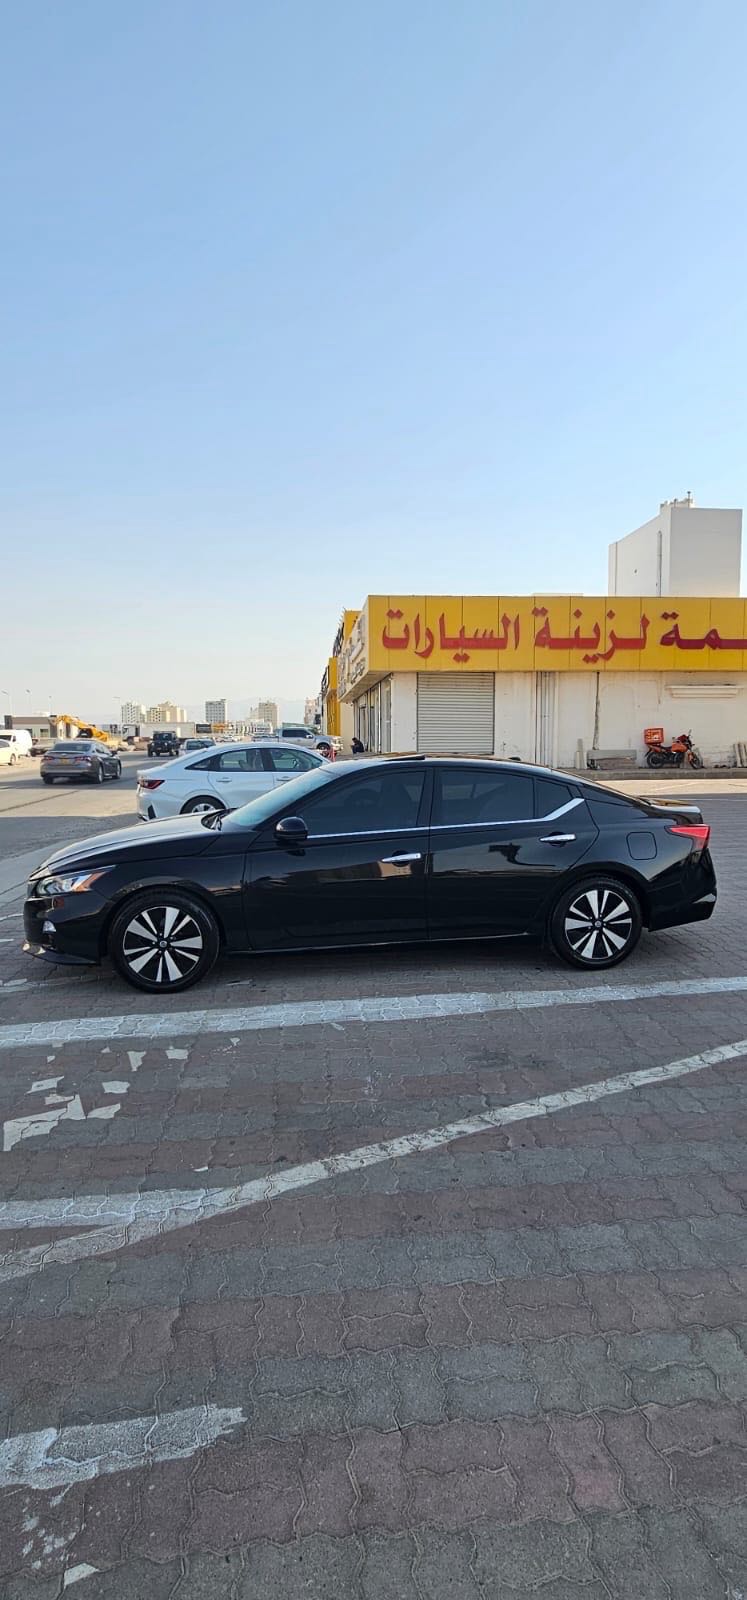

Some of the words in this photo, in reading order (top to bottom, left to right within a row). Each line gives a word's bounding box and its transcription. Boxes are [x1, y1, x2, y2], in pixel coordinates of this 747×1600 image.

[382, 608, 520, 664] السيارات
[531, 607, 650, 664] لزينة
[660, 612, 747, 650] مة
